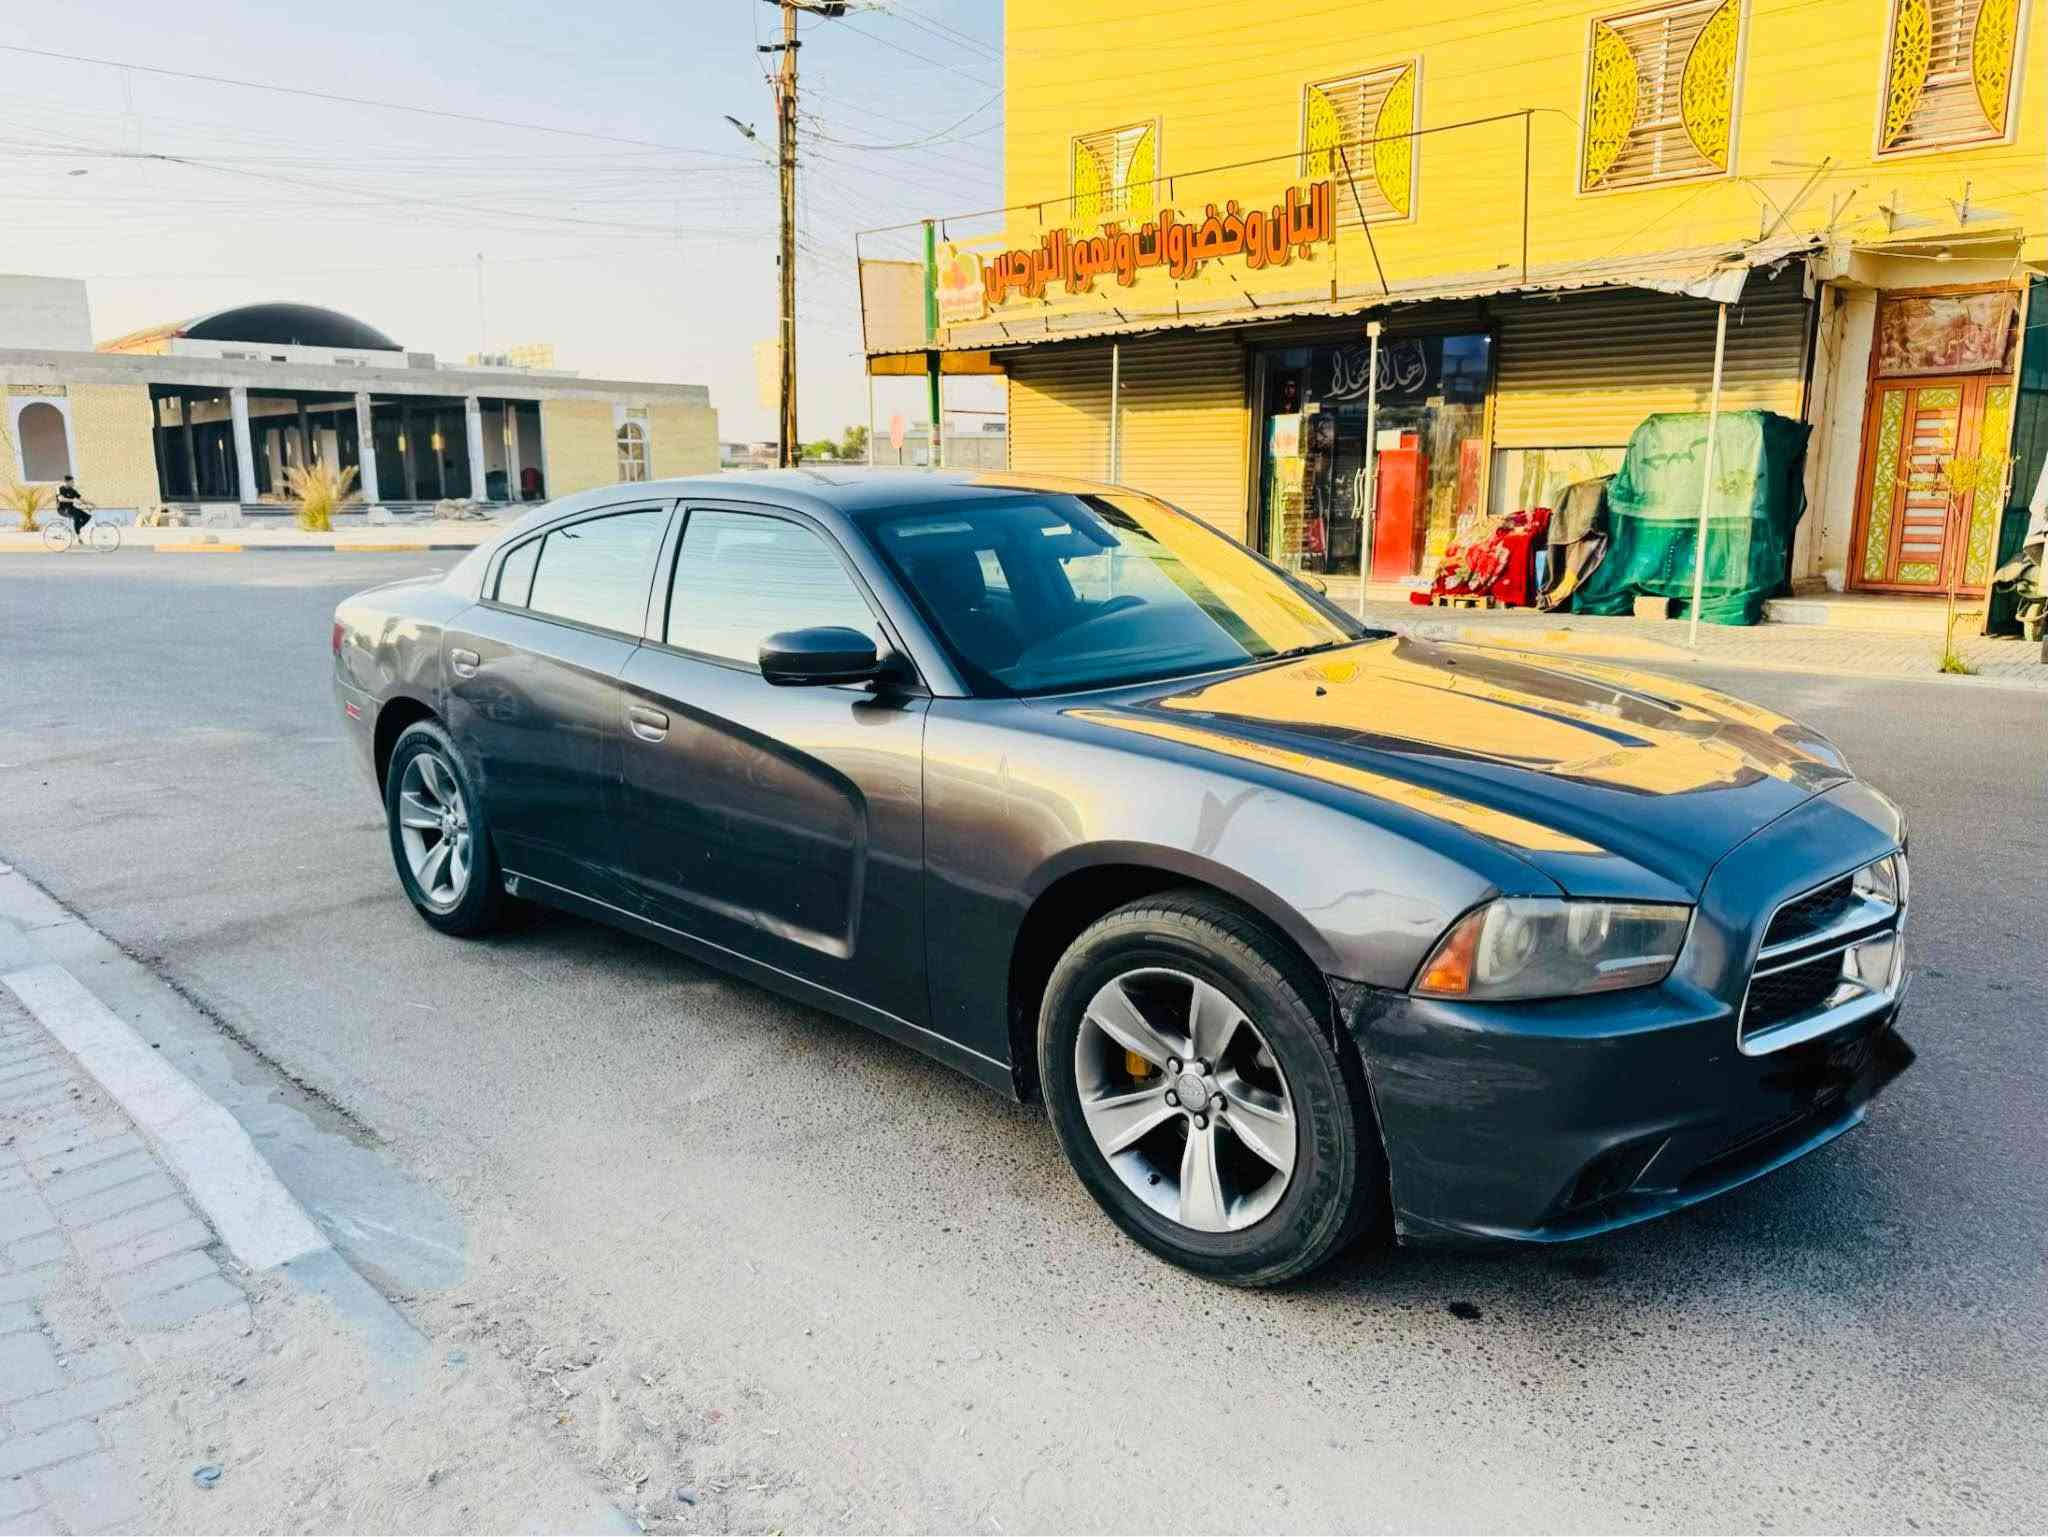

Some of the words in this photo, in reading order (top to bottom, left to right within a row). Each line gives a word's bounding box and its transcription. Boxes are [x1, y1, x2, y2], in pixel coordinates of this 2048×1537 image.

[1064, 222, 1135, 294] وتمور
[1133, 199, 1265, 280] وخضروات
[1264, 180, 1330, 266] البان
[984, 228, 1066, 305] النرجس
